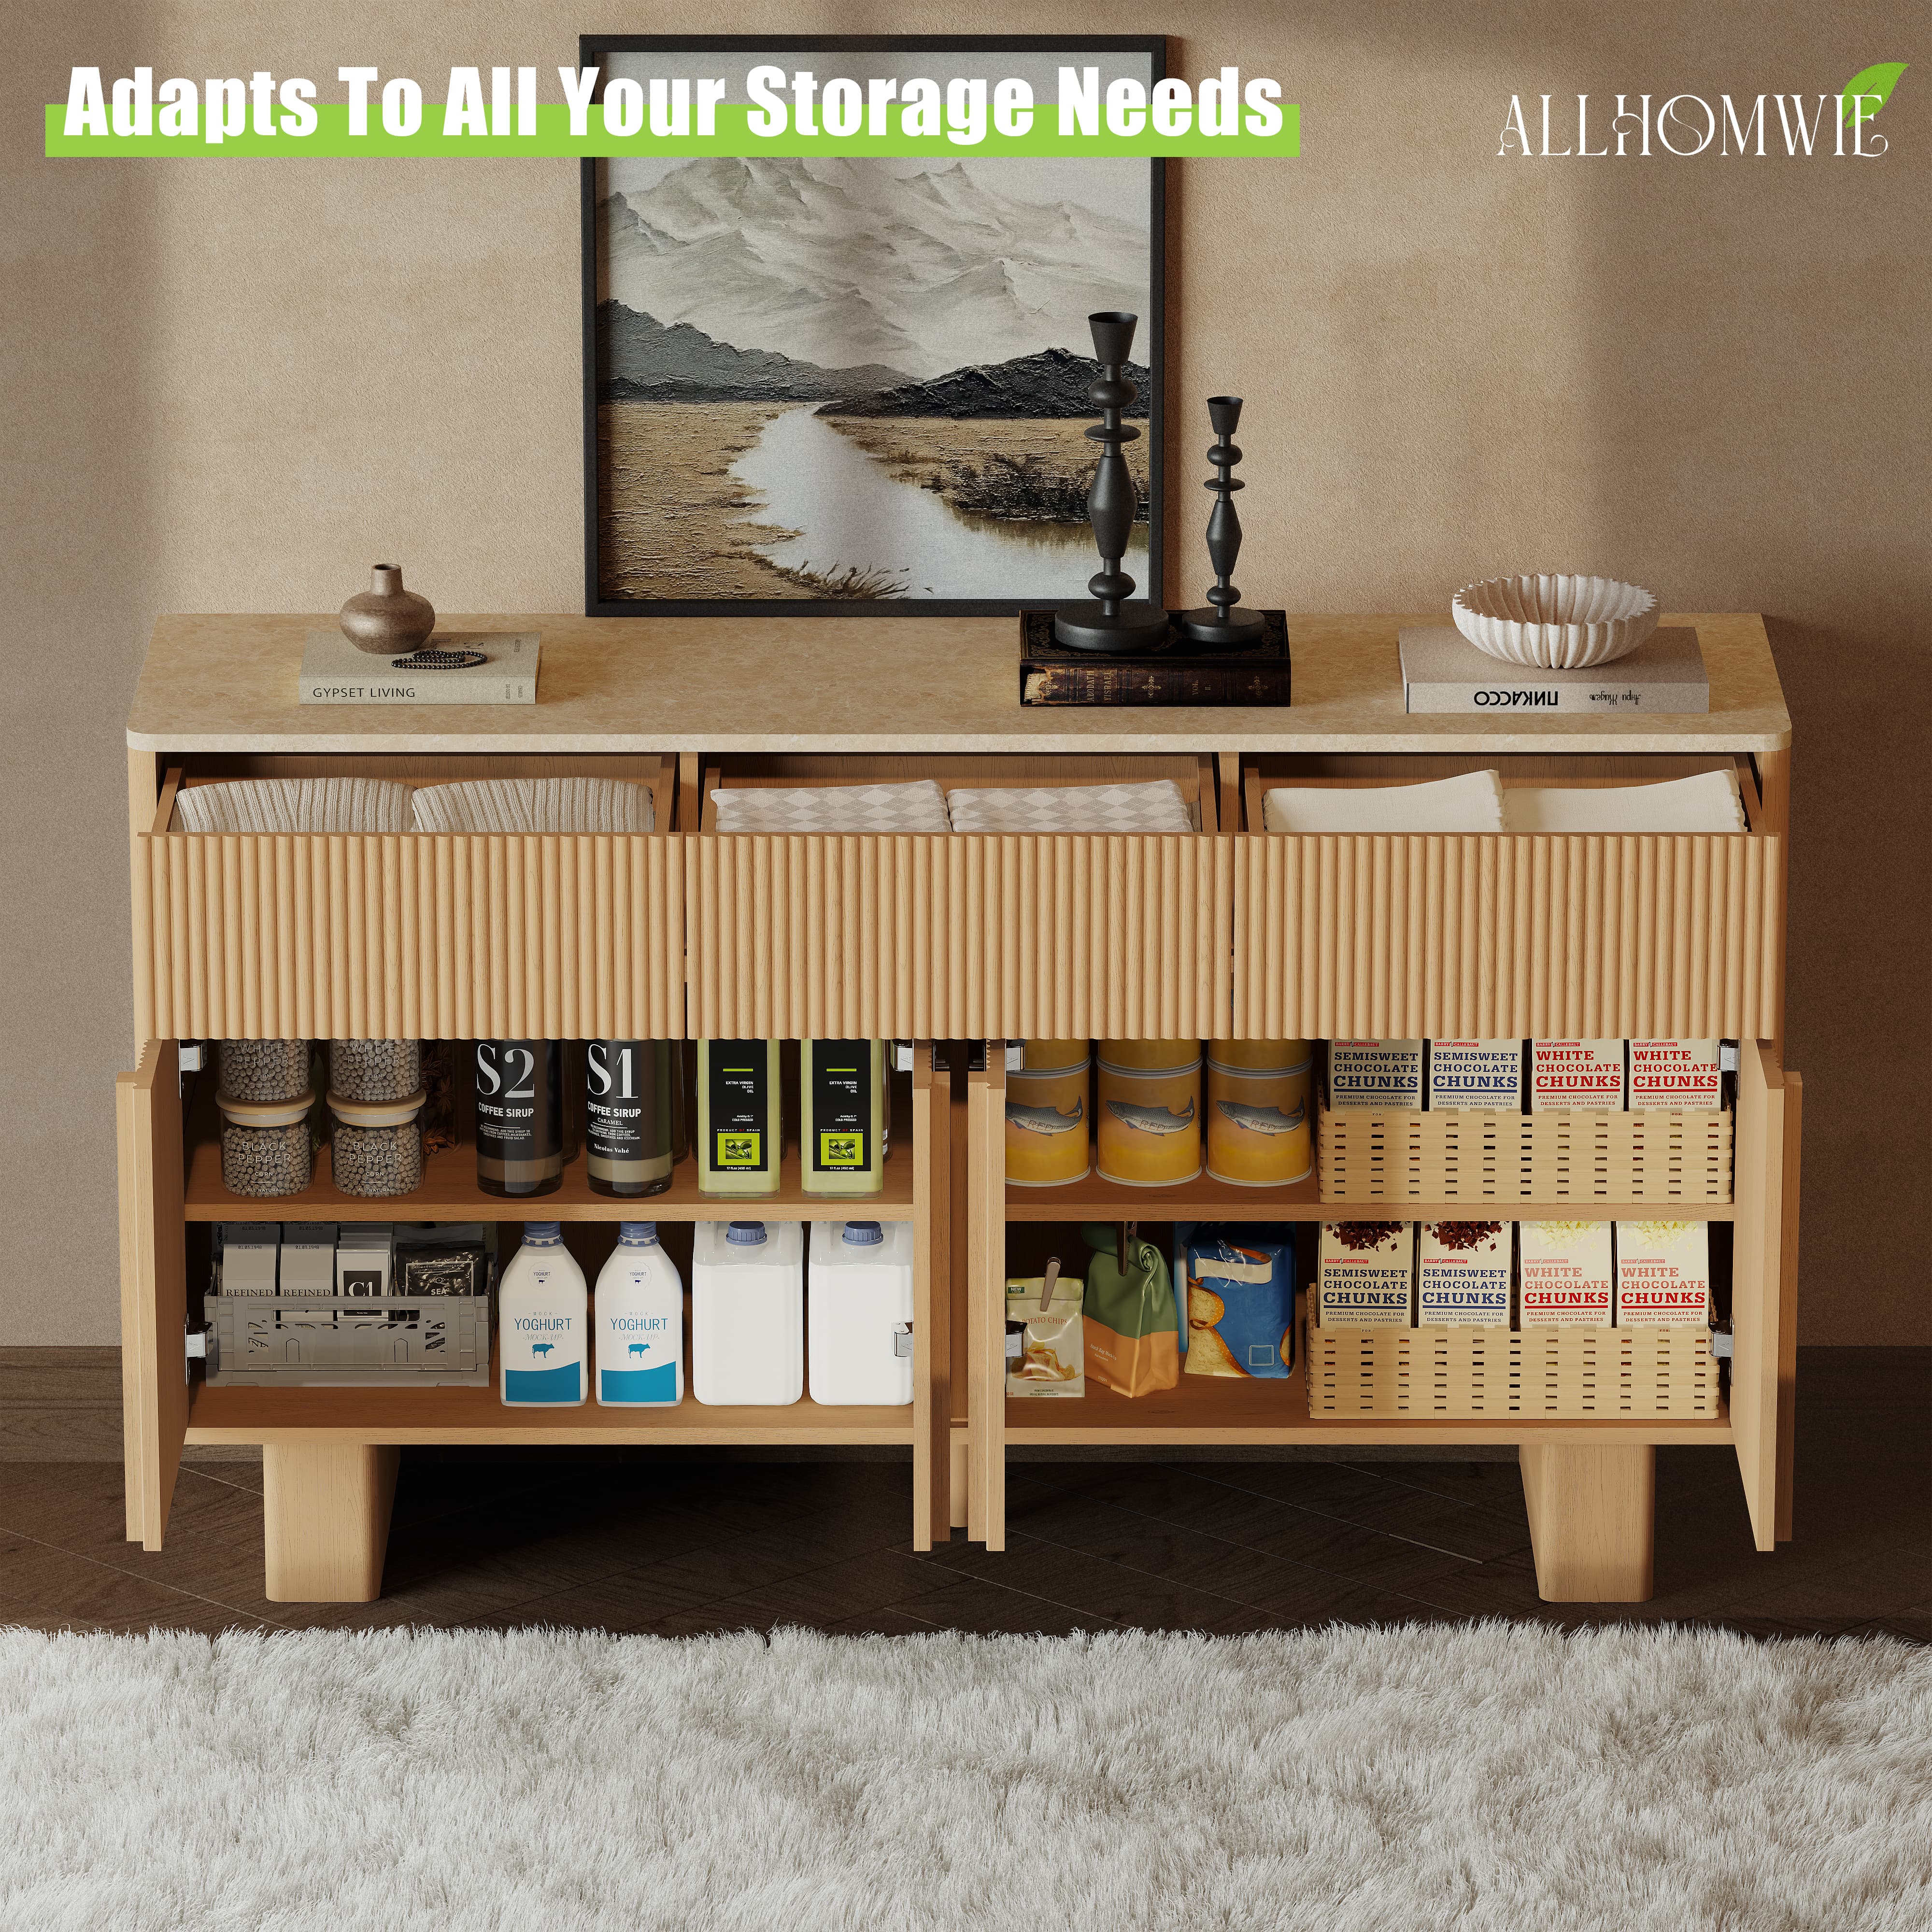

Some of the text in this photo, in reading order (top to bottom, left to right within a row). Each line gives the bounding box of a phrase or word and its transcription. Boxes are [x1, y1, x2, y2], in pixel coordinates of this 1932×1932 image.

[313, 688, 415, 697] GYPSET LIVING
[1589, 690, 1641, 705] Анри Жидель
[1474, 691, 1558, 706] ПИКАССО
[241, 1043, 284, 1052] WHITE
[352, 1043, 395, 1052] WHITE
[236, 1056, 289, 1065] PEPPER
[347, 1056, 399, 1065] PEPPER
[1335, 1052, 1418, 1061] SEMISWEET
[1434, 1052, 1518, 1061] SEMISWEET
[1536, 1051, 1594, 1060] WHITE
[1634, 1051, 1691, 1060] WHITE
[477, 1044, 535, 1098] S2
[587, 1044, 639, 1098] S1
[1334, 1064, 1418, 1073] CHOCOLATE
[1434, 1064, 1517, 1073] CHOCOLATE
[1536, 1064, 1620, 1072] CHOCOLATE
[1634, 1064, 1718, 1072] CHOCOLATE
[1334, 1076, 1418, 1088] CHUNKS
[1434, 1076, 1517, 1088] CHUNKS
[1536, 1075, 1620, 1087] CHUNKS
[1634, 1075, 1718, 1087] CHUNKS
[479, 1102, 534, 1117] COFFEE SIRUP
[588, 1101, 641, 1117] COFFEE SIRUP
[1026, 1120, 1054, 1132] RED
[1138, 1120, 1165, 1132] RED
[1250, 1120, 1277, 1132] RED
[242, 1142, 286, 1151] BLACK
[354, 1142, 397, 1151] BLACK
[594, 1143, 613, 1152] Nicolas
[239, 1154, 290, 1164] PEPPER
[350, 1154, 401, 1164] PEPPER
[1324, 1269, 1407, 1278] SEMISWEET
[1423, 1269, 1506, 1278] SEMISWEET
[1525, 1267, 1582, 1277] WHITE
[1621, 1267, 1679, 1277] WHITE
[348, 1281, 373, 1296] C1
[1324, 1280, 1407, 1289] CHOCOLATE
[1423, 1280, 1506, 1289] CHOCOLATE
[1525, 1280, 1608, 1289] CHOCOLATE
[1621, 1280, 1705, 1289] CHOCOLATE
[431, 1287, 446, 1295] SEA
[1324, 1292, 1407, 1304] CHUNKS
[1422, 1292, 1506, 1304] CHUNKS
[1525, 1292, 1608, 1304] CHUNKS
[1621, 1292, 1705, 1304] CHUNKS
[514, 1318, 572, 1331] YOGHURT
[610, 1318, 668, 1331] YOGHURT
